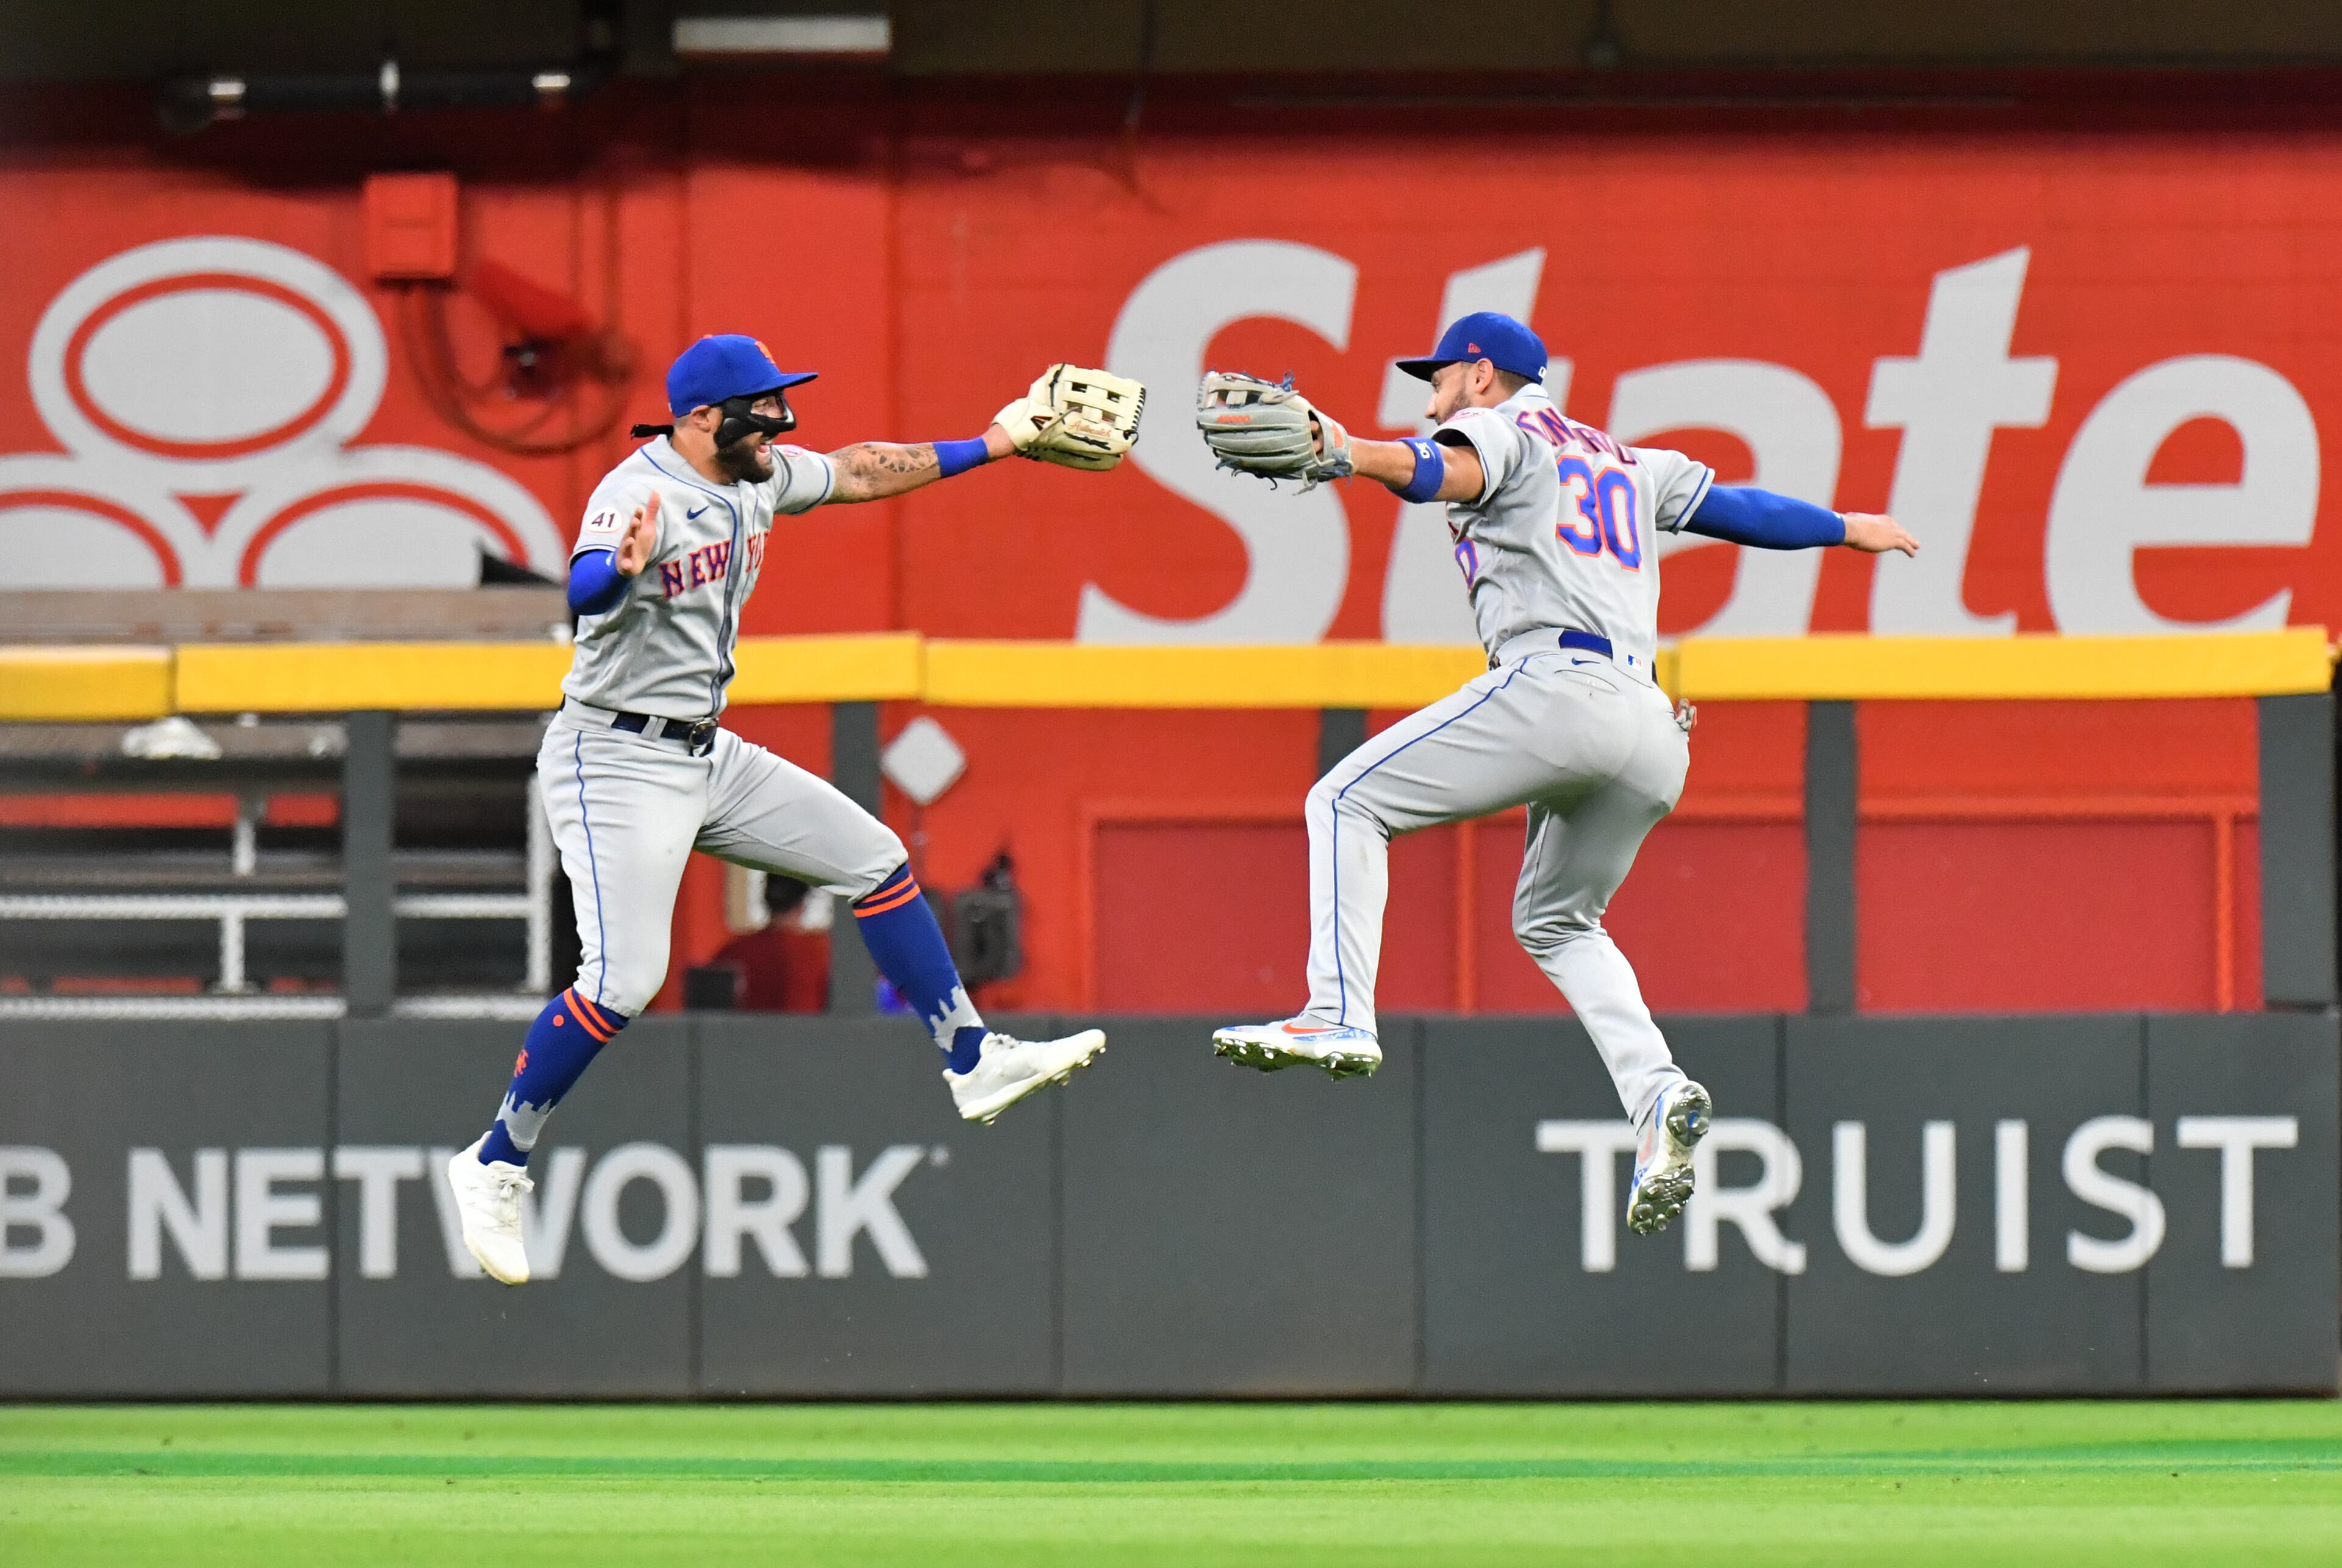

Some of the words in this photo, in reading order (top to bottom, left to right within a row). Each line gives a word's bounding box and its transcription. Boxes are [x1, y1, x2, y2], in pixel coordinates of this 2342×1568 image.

[591, 512, 615, 528] 41
[658, 539, 732, 600] NEW
[1556, 456, 1642, 572] 30
[127, 1142, 929, 1281] NETWORK
[1535, 1115, 2299, 1276] TRUIST
